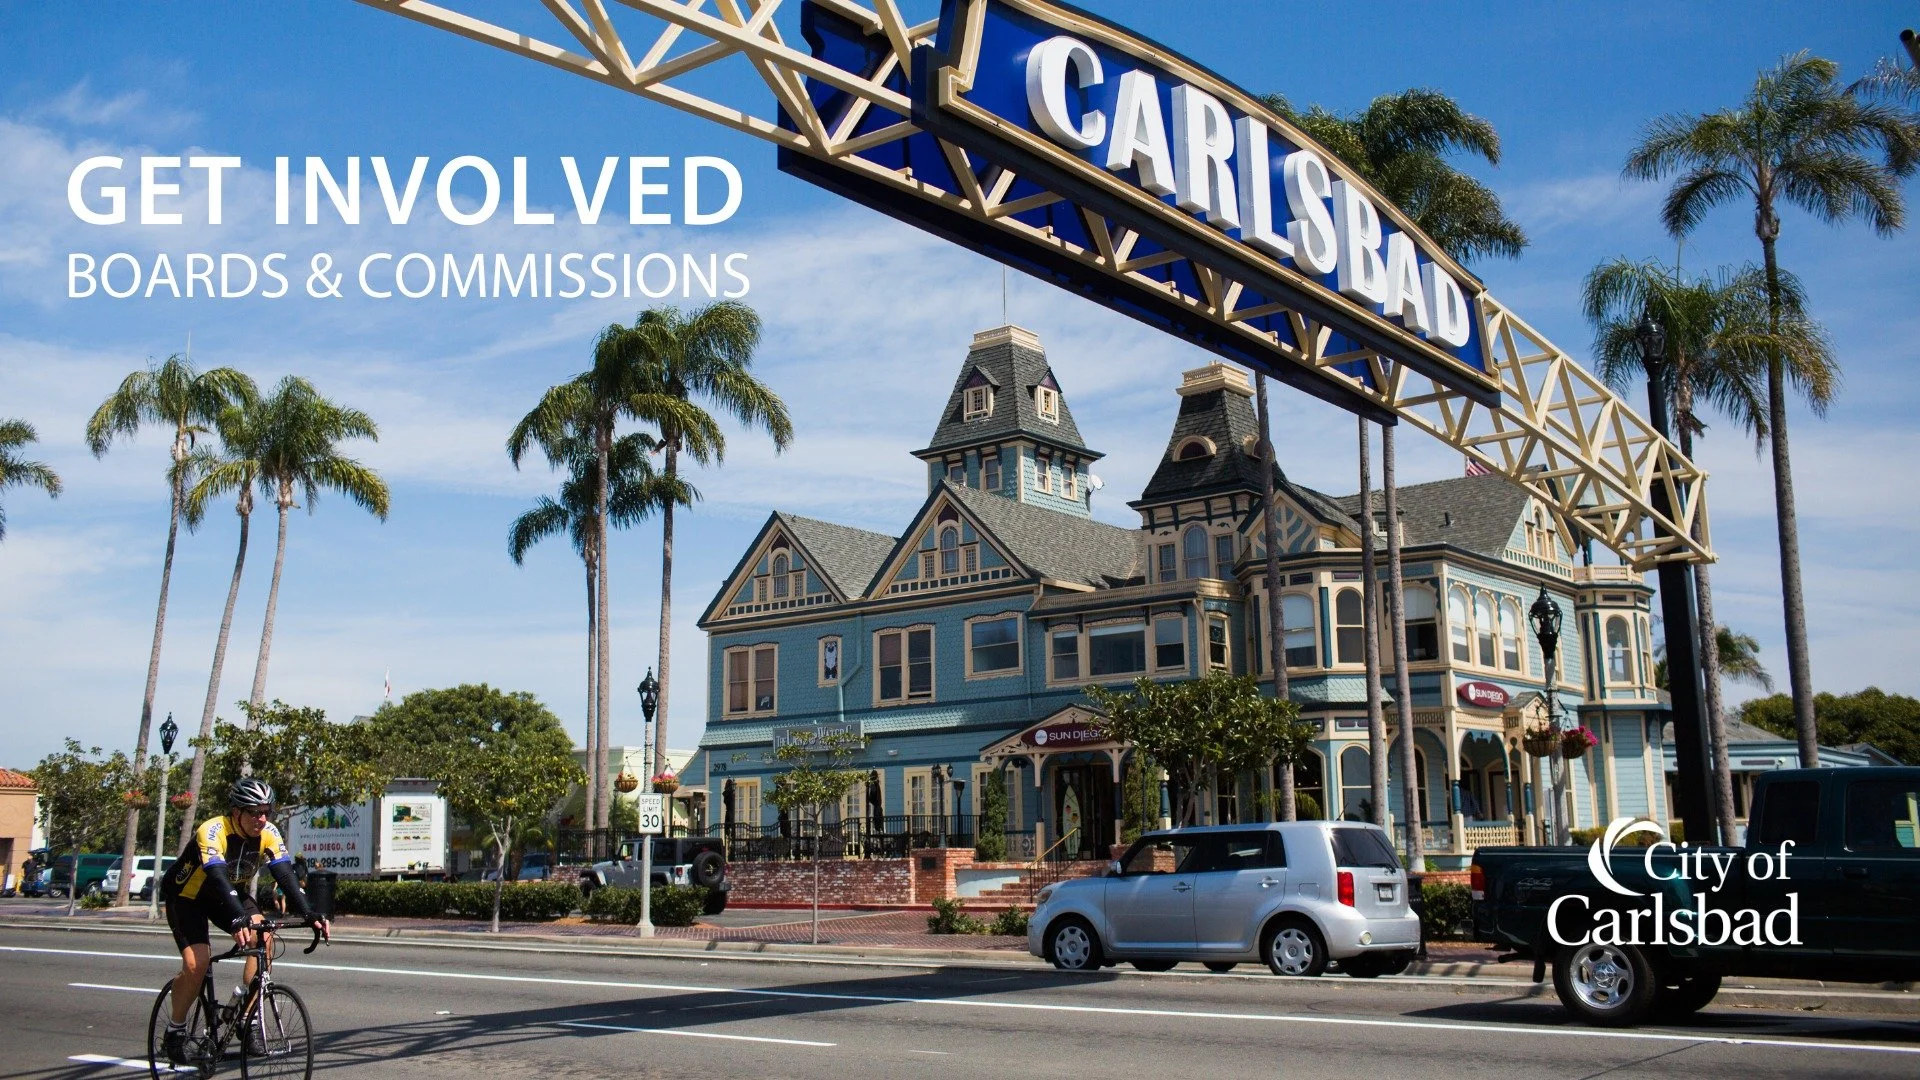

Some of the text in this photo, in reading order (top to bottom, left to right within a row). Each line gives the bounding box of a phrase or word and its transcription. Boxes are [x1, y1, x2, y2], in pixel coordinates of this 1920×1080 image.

[1026, 35, 1470, 348] CARLSBAD
[1475, 689, 1487, 698] SUN
[1049, 729, 1102, 742] SUN DIEG
[642, 814, 660, 828] 30
[303, 842, 356, 852] SAN DIEGO, CA
[321, 857, 360, 868] 295-3173
